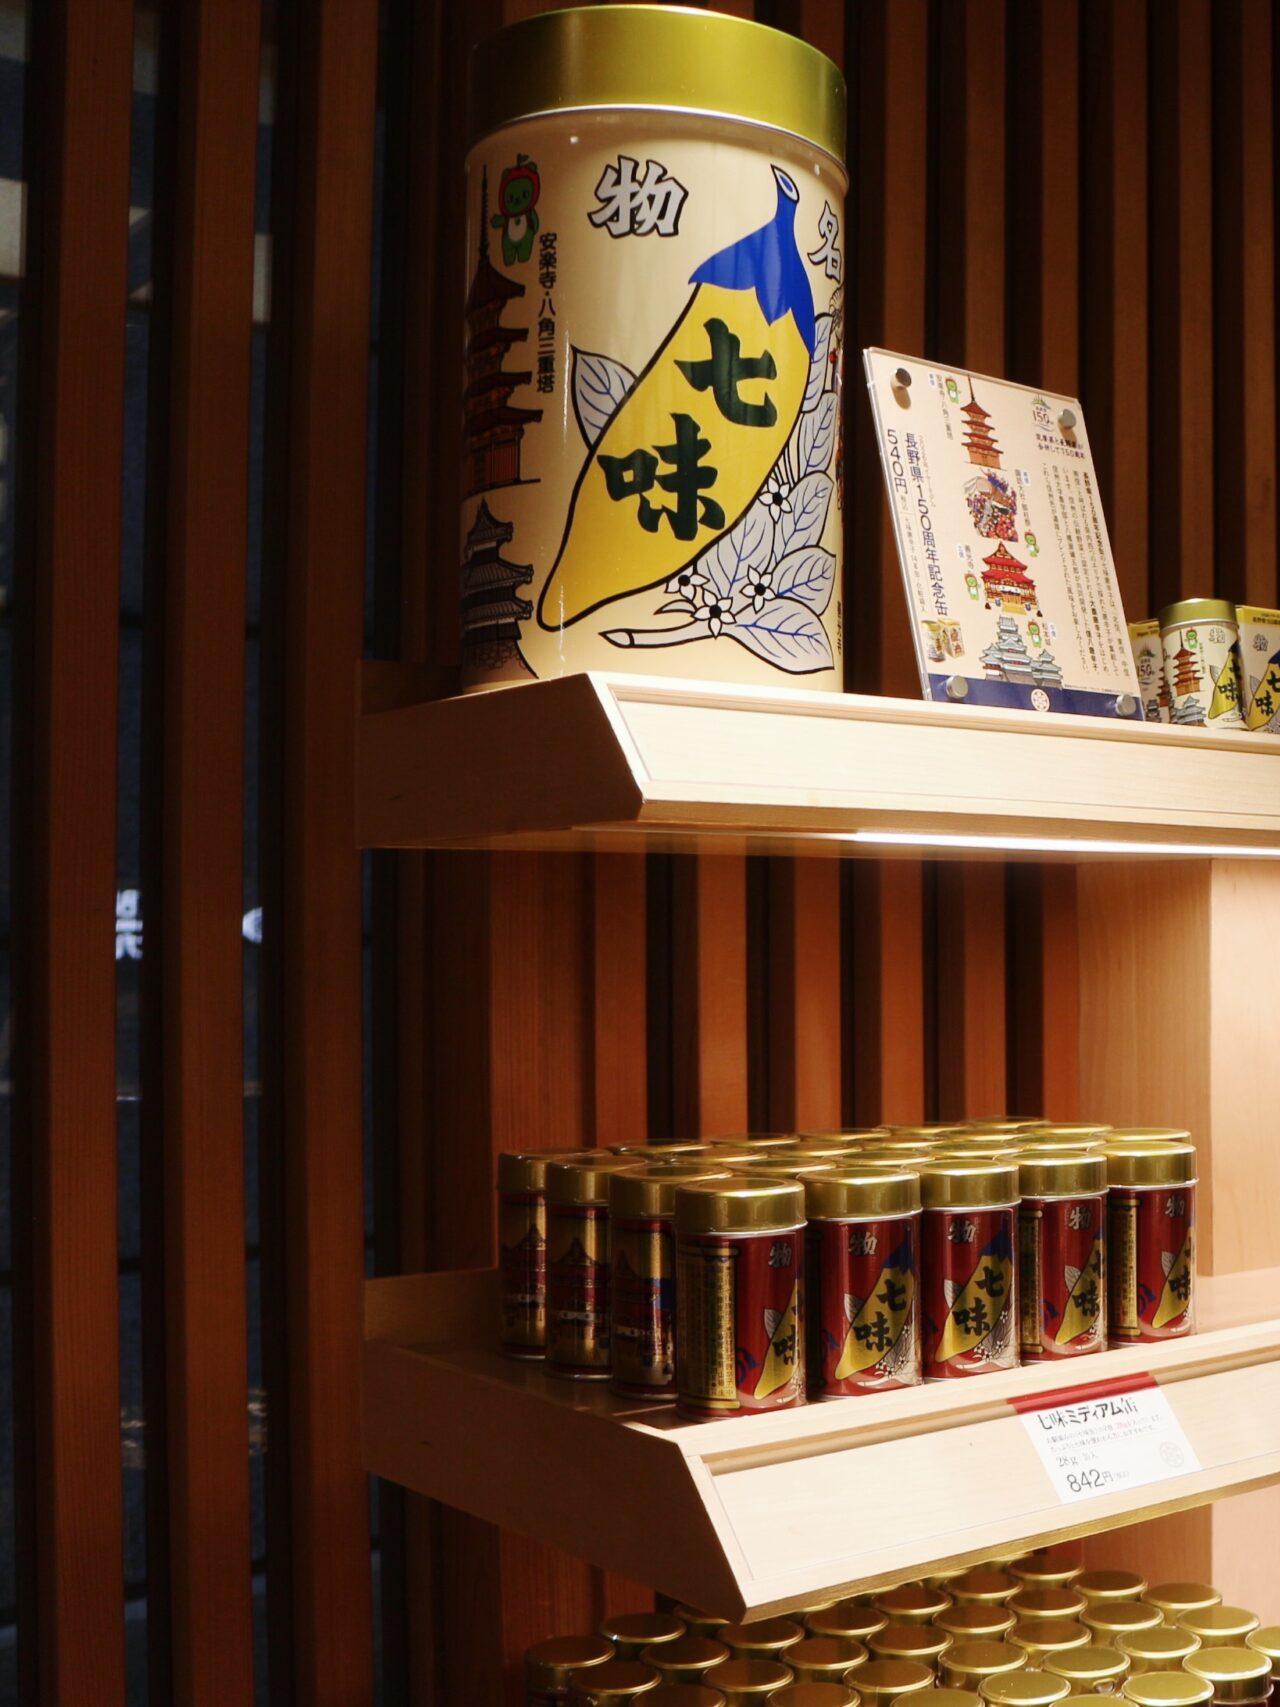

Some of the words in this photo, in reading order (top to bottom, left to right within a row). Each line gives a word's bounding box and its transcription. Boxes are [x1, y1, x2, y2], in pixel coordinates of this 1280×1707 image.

[588, 155, 689, 238] 物
[807, 200, 843, 284] 名
[537, 233, 557, 393] 安楽寺・八角三重塔
[597, 318, 777, 541] 七味
[887, 429, 908, 494] 540円
[905, 433, 948, 616] 長野県150周年記念缶
[947, 1219, 977, 1244] 物
[1068, 1206, 1091, 1230] 物
[1165, 1195, 1185, 1218] 物
[768, 1243, 792, 1268] 物
[848, 1231, 878, 1255] 物
[853, 1279, 906, 1352] 七味
[952, 1266, 1004, 1337] 七味
[1066, 1468, 1114, 1493] 842円
